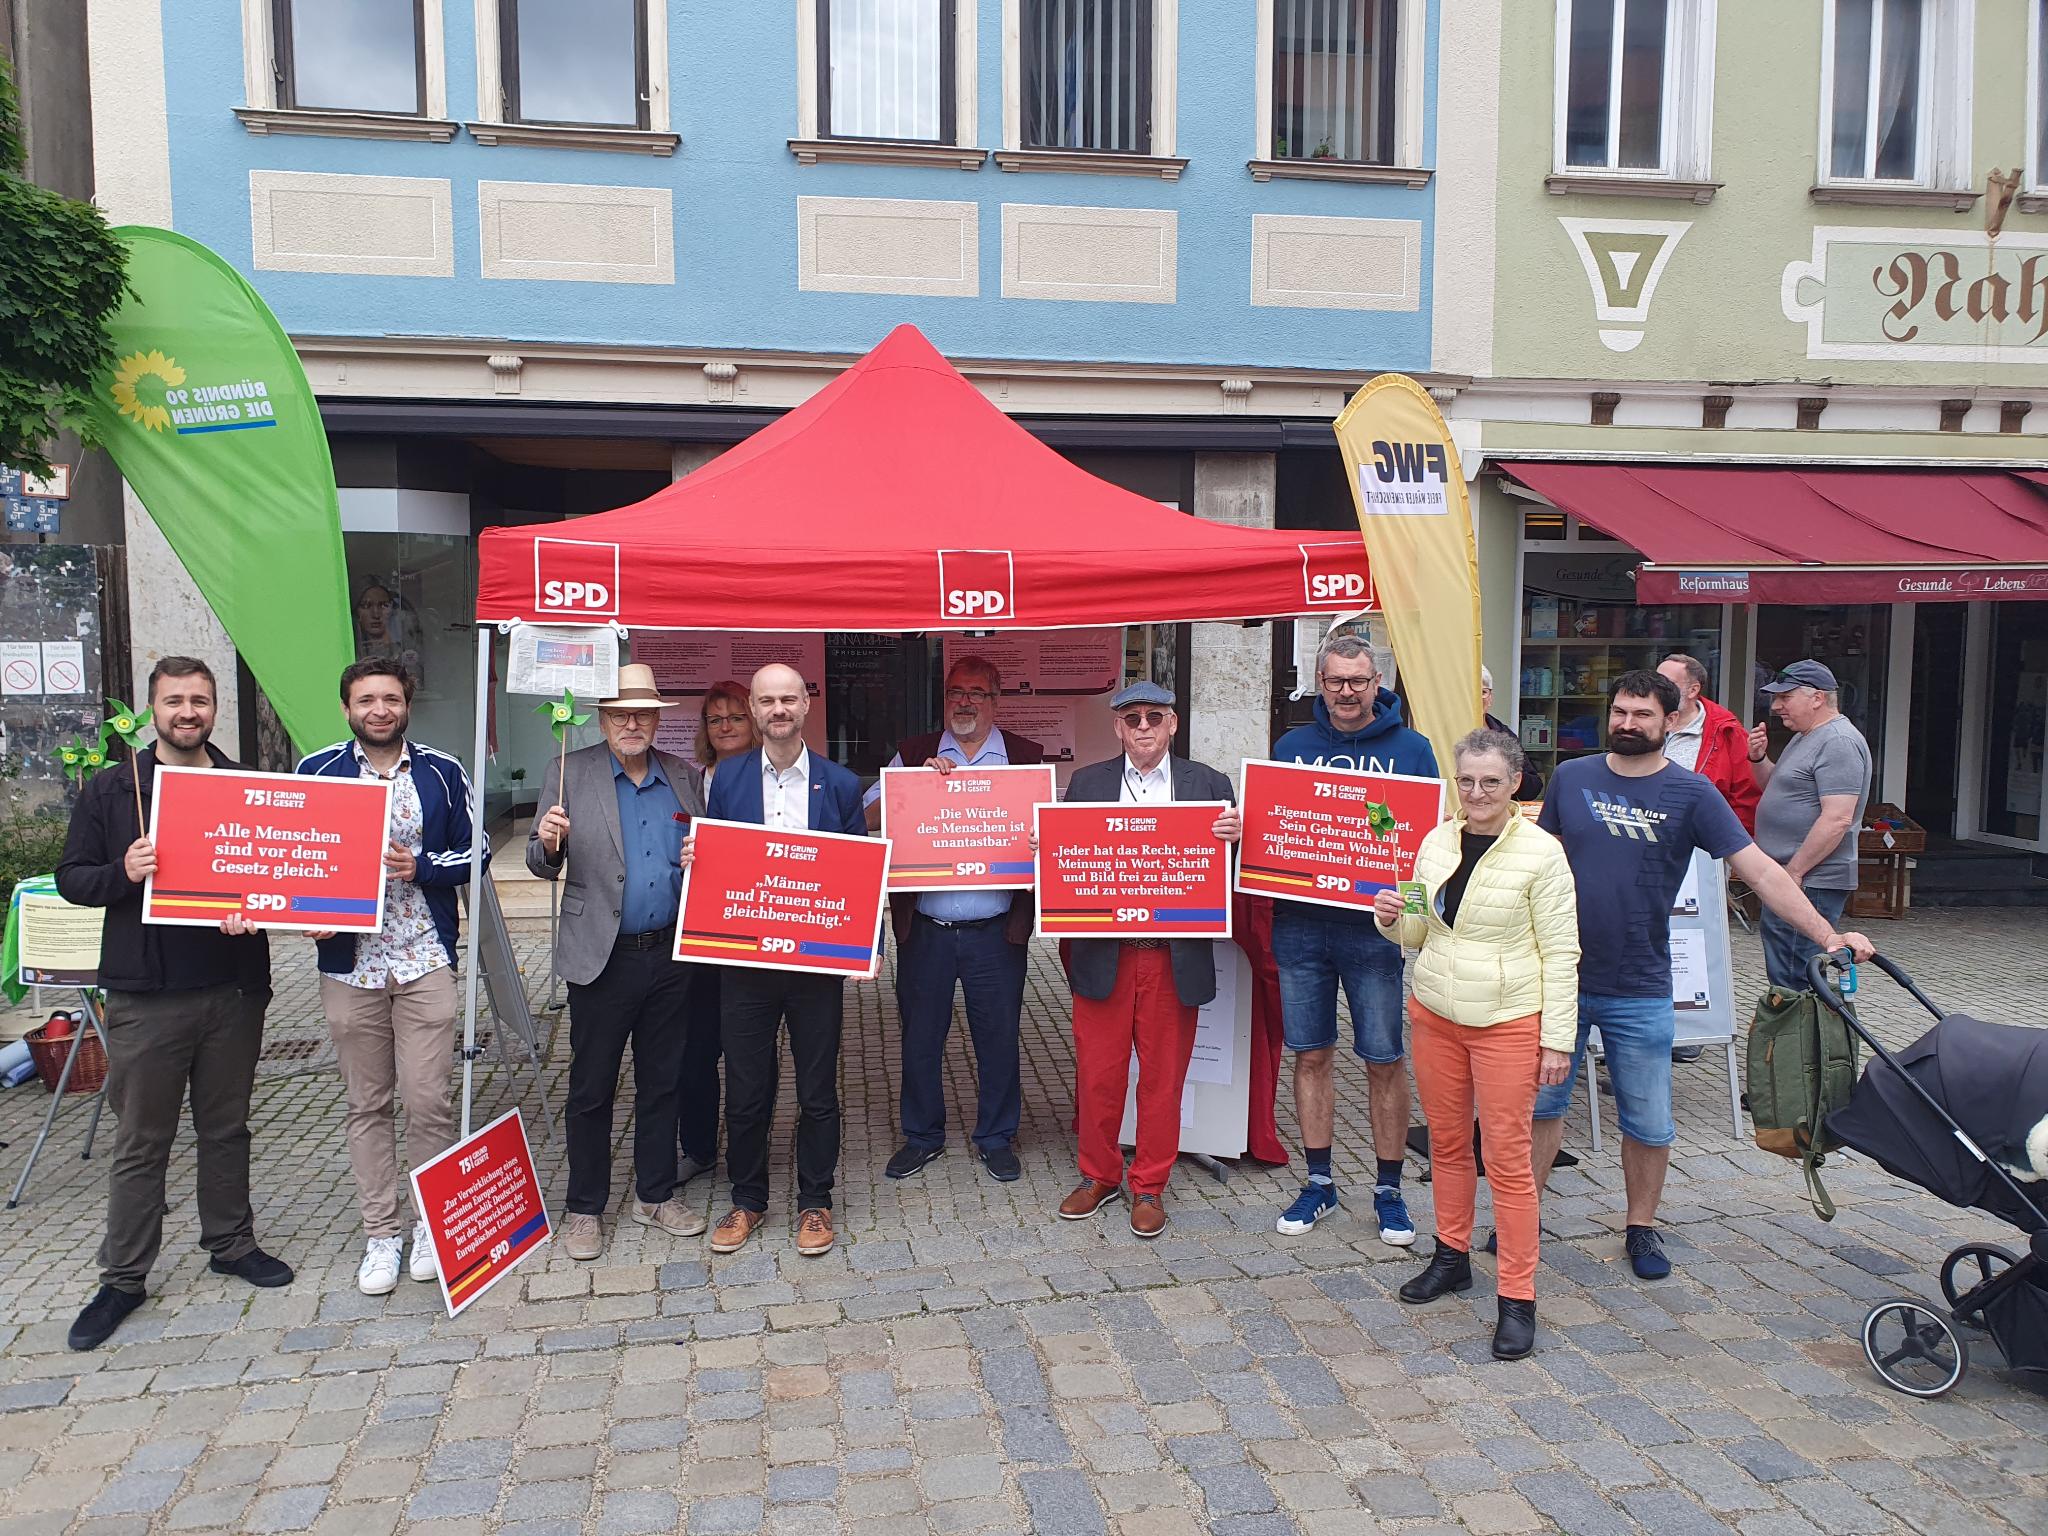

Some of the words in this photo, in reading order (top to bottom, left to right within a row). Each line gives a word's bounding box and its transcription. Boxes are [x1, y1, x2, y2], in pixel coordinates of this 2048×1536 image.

[1312, 574, 1365, 598] SPD
[1679, 577, 1749, 594] Reformhaus
[1898, 578, 1952, 592] Gesunde
[543, 581, 608, 608] SPD
[948, 590, 1004, 614] SPD
[946, 781, 961, 792] 75
[1313, 782, 1331, 797] 75
[1339, 785, 1367, 794] GRUND
[244, 789, 265, 805] 75
[274, 791, 306, 801] GRUND
[273, 799, 304, 808] GESETZ
[1338, 792, 1366, 801] GESETZ
[934, 808, 961, 821] „Die
[965, 807, 1008, 819] Würde
[1267, 805, 1332, 822] „Eigentum
[1336, 814, 1414, 831] verpftet.
[1645, 810, 1667, 819] flow
[917, 823, 938, 834] des
[942, 822, 1006, 833] Menschen
[1010, 821, 1025, 832] ist
[1106, 818, 1123, 831] 75
[1279, 819, 1307, 831] Sein
[1310, 823, 1372, 841] Gebrauch
[204, 823, 250, 839] „Alle
[256, 825, 341, 844] Menschen
[765, 842, 783, 857] 75
[791, 845, 818, 854] GRUND
[932, 836, 1018, 848] unantastbar.“
[1052, 845, 1090, 856] „Jeder
[1094, 844, 1113, 855] hat
[1117, 844, 1138, 855] das
[1141, 844, 1180, 856] Recht,
[1184, 846, 1216, 855] seine
[1263, 832, 1314, 847] zugleich
[1318, 838, 1345, 851] dem
[1349, 841, 1389, 856] Wohle
[215, 843, 252, 857] sind
[259, 847, 287, 858] vor
[292, 845, 328, 860] dem
[790, 852, 816, 861] GESETZ
[1265, 844, 1352, 866] Allgemeinheit
[211, 859, 269, 876] Gesetz
[273, 863, 338, 880] gleich.“
[956, 862, 986, 875] SPD
[1058, 859, 1111, 871] Meinung
[1115, 858, 1130, 869] in
[1131, 859, 1164, 870] Wort,
[1168, 858, 1210, 869] Schrift
[756, 874, 821, 892] „Männer
[1063, 871, 1086, 882] und
[1090, 871, 1115, 882] Bild
[1119, 871, 1139, 882] frei
[1143, 874, 1157, 882] zu
[1162, 871, 1205, 882] äußern
[1316, 875, 1350, 891] SPD
[1075, 885, 1099, 895] und
[1102, 887, 1117, 895] zu
[1121, 884, 1193, 895] verbreiten.“
[246, 893, 286, 911] SPD
[726, 889, 754, 902] und
[758, 891, 810, 908] Frauen
[815, 896, 845, 911] sind
[723, 903, 851, 929] gleichberechtigt.“
[1116, 908, 1149, 922] SPD
[761, 937, 795, 953] SPD
[459, 1157, 470, 1175] 75
[472, 1145, 488, 1159] GRUND
[474, 1153, 489, 1168] GESETZ
[458, 1169, 503, 1203] Verwirklichung
[503, 1156, 518, 1174] eines
[444, 1200, 473, 1225] vereinten
[472, 1184, 497, 1206] Europas
[498, 1172, 513, 1190] wirkt
[514, 1166, 523, 1179] die
[444, 1200, 493, 1239] Bundesrepublik
[492, 1177, 527, 1207] Deutschland
[455, 1231, 466, 1246] bei
[466, 1224, 478, 1239] der
[478, 1199, 515, 1233] Entwicklung
[514, 1192, 524, 1206] der
[456, 1224, 497, 1260] Europäischen
[497, 1215, 515, 1233] Union
[490, 1240, 509, 1264] SPD
